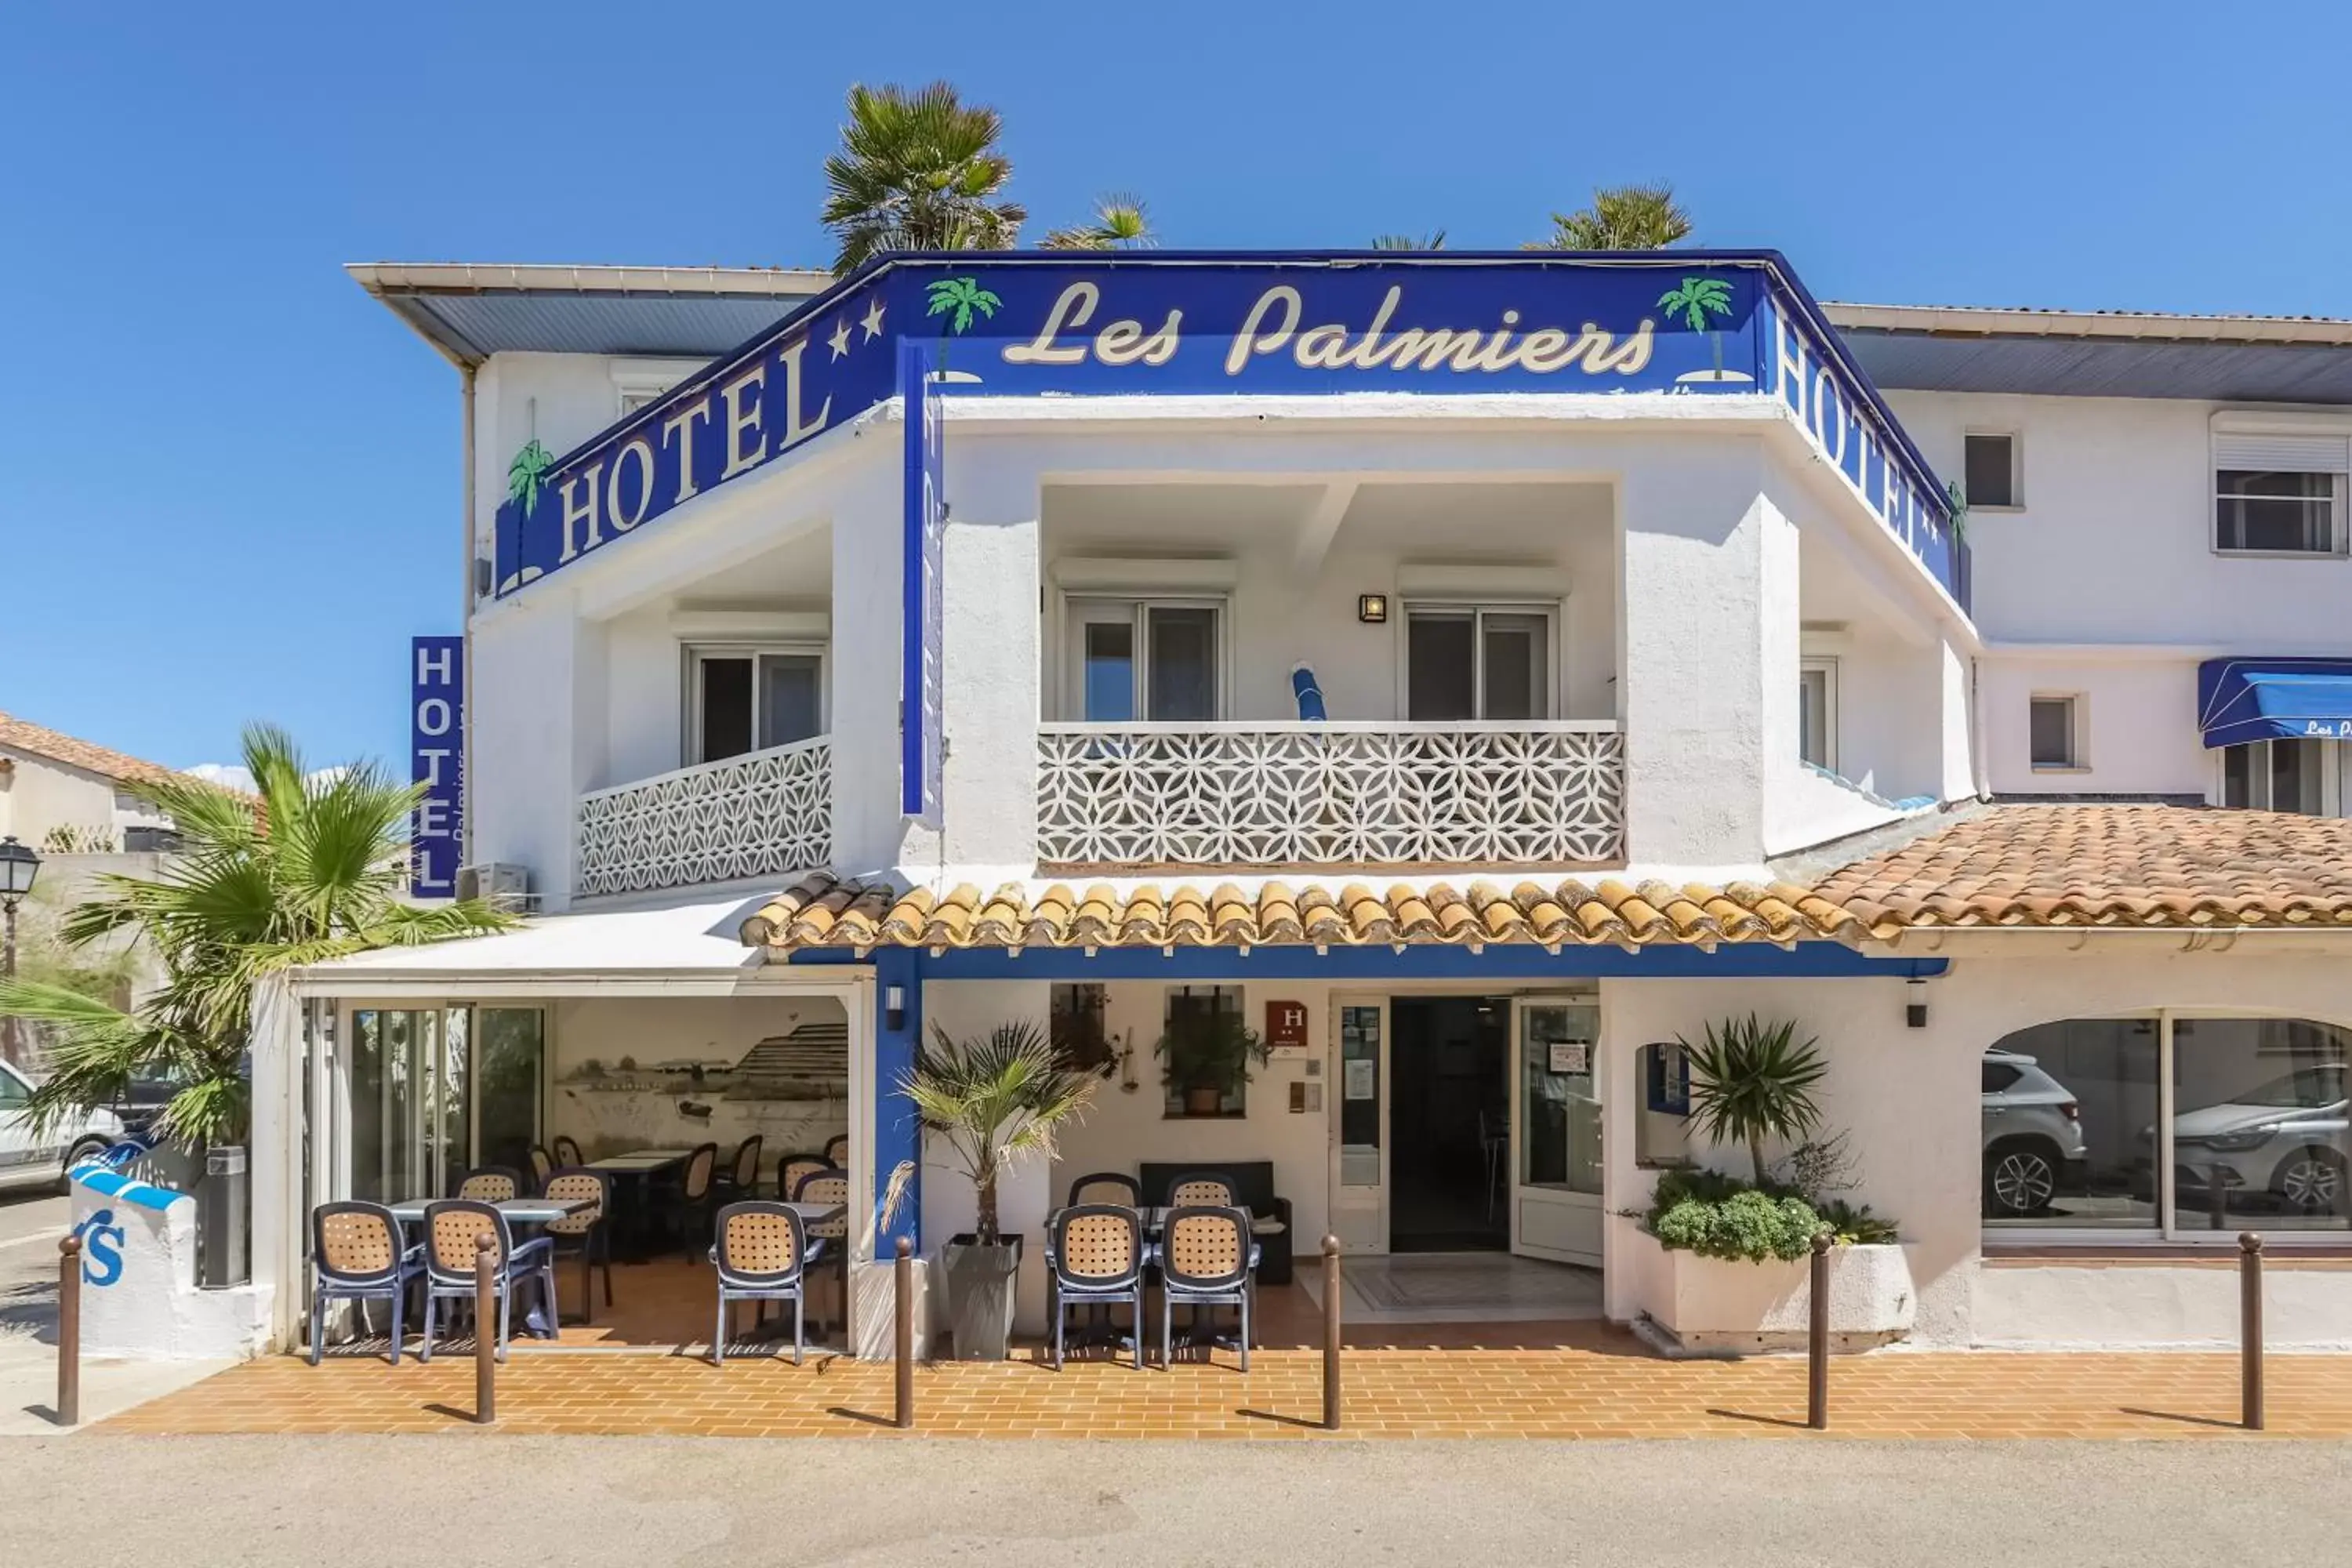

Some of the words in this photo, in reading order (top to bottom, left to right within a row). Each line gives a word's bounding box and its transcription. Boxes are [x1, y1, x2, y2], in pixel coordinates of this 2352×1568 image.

[1002, 281, 1184, 366] Les
[1225, 285, 1654, 376] Palmiers
[1770, 292, 1924, 561] HOTEL
[558, 338, 832, 563] HOTEL
[418, 648, 451, 887] HOTEL
[1283, 1009, 1304, 1027] H
